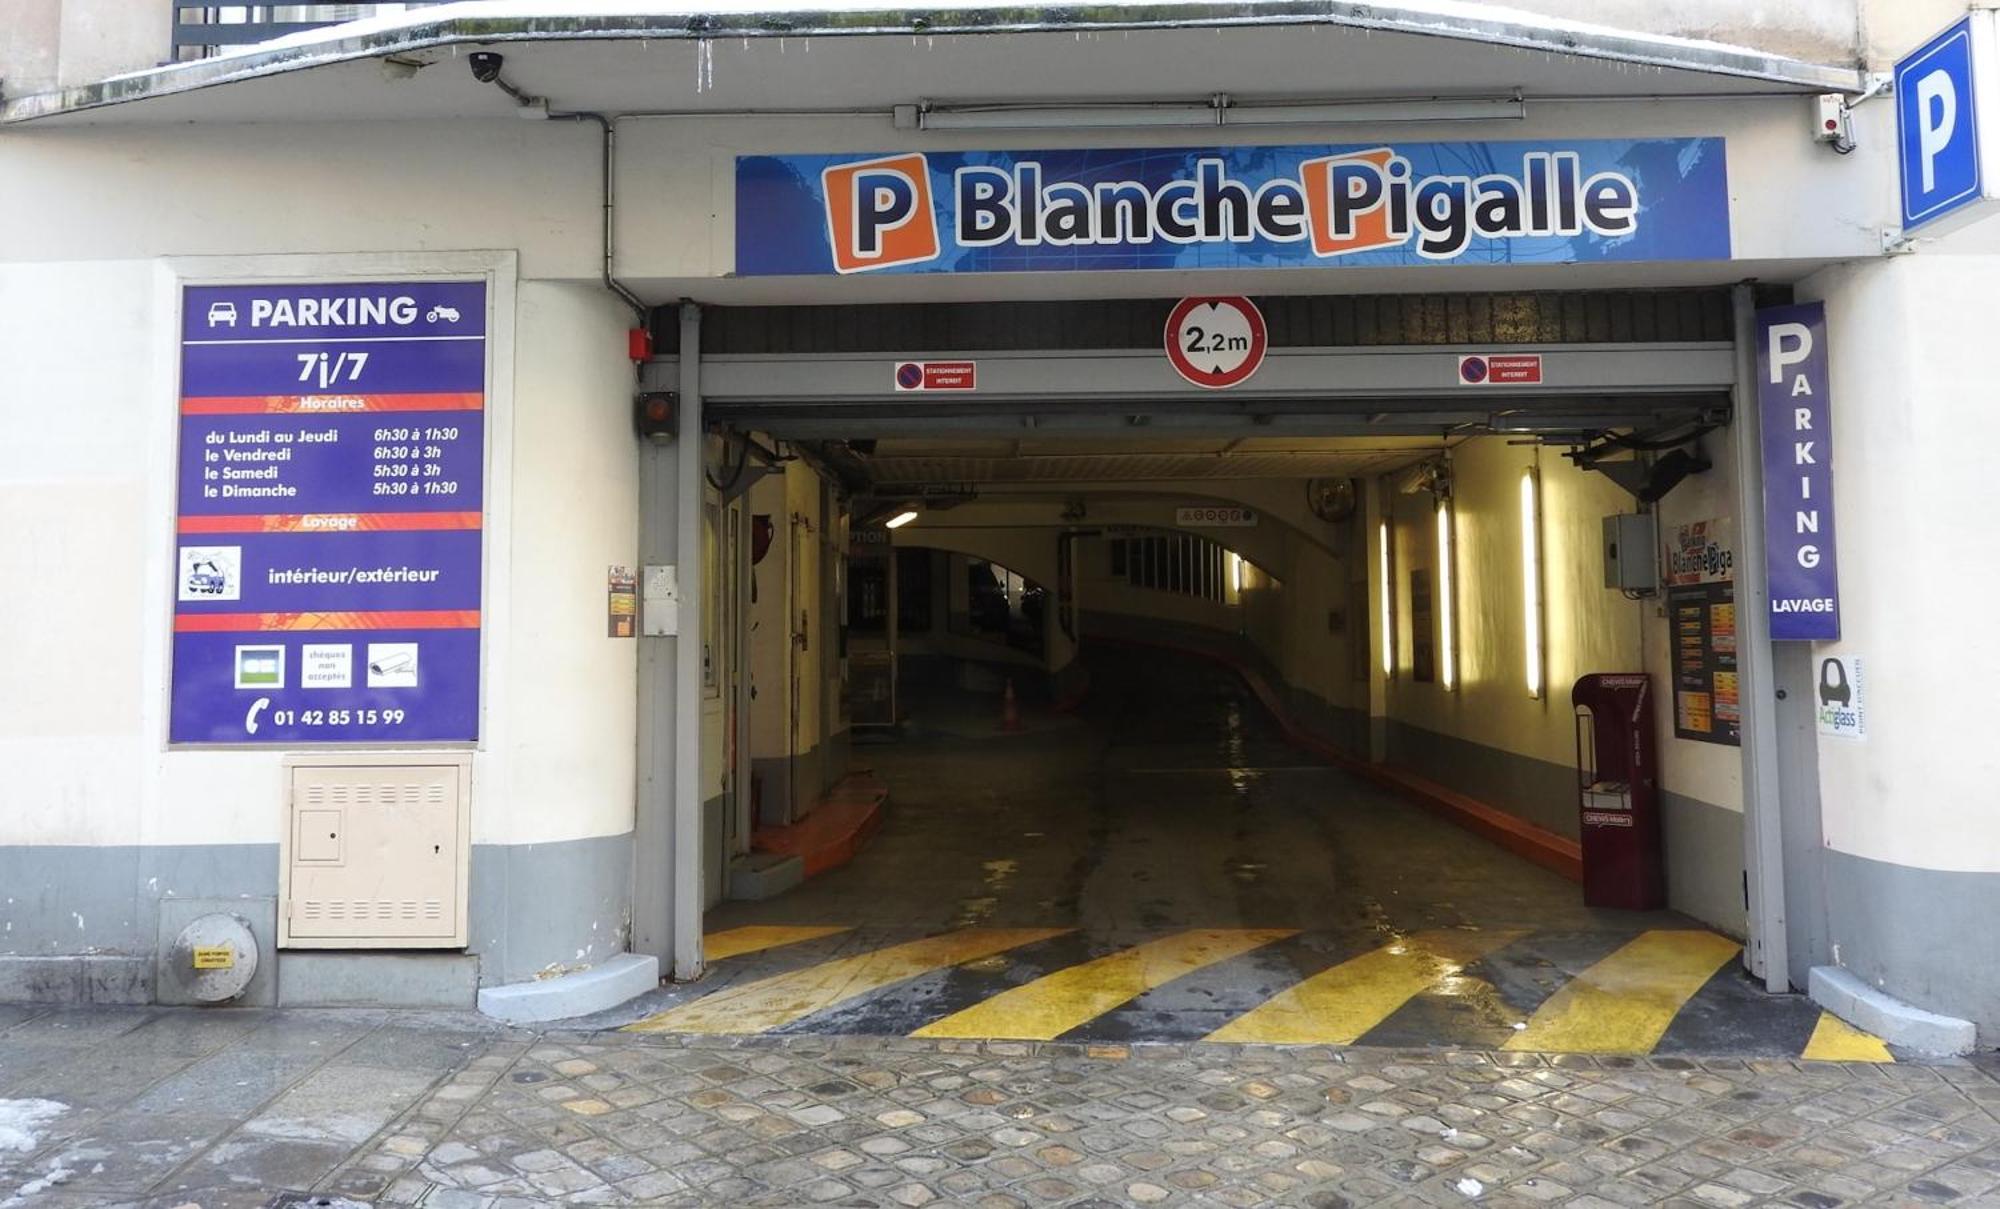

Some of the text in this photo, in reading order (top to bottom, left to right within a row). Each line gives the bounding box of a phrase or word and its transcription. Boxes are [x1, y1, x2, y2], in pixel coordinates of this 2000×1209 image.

[1917, 69, 1957, 194] P
[852, 151, 1639, 260] P Blanche Pigalle
[250, 297, 418, 327] PARKING
[297, 352, 369, 389] 7j/7
[300, 396, 365, 410] Horaires
[206, 430, 338, 444] du Lundi au Jeudi
[374, 427, 458, 441] 6h30 à 1h30
[205, 448, 291, 461] le Vendredi
[374, 446, 441, 459] 6h30 à 3h
[205, 467, 278, 480] le Samedi
[373, 464, 441, 477] 5h30 à 3h
[204, 484, 297, 497] le Dimanche
[373, 481, 457, 495] 5h30 à 1h30
[302, 516, 357, 529] Lavage
[268, 567, 439, 585] intérieur/extérieur
[1771, 598, 1833, 613] LAVAGE
[274, 709, 404, 726] 01 42 85 15 99
